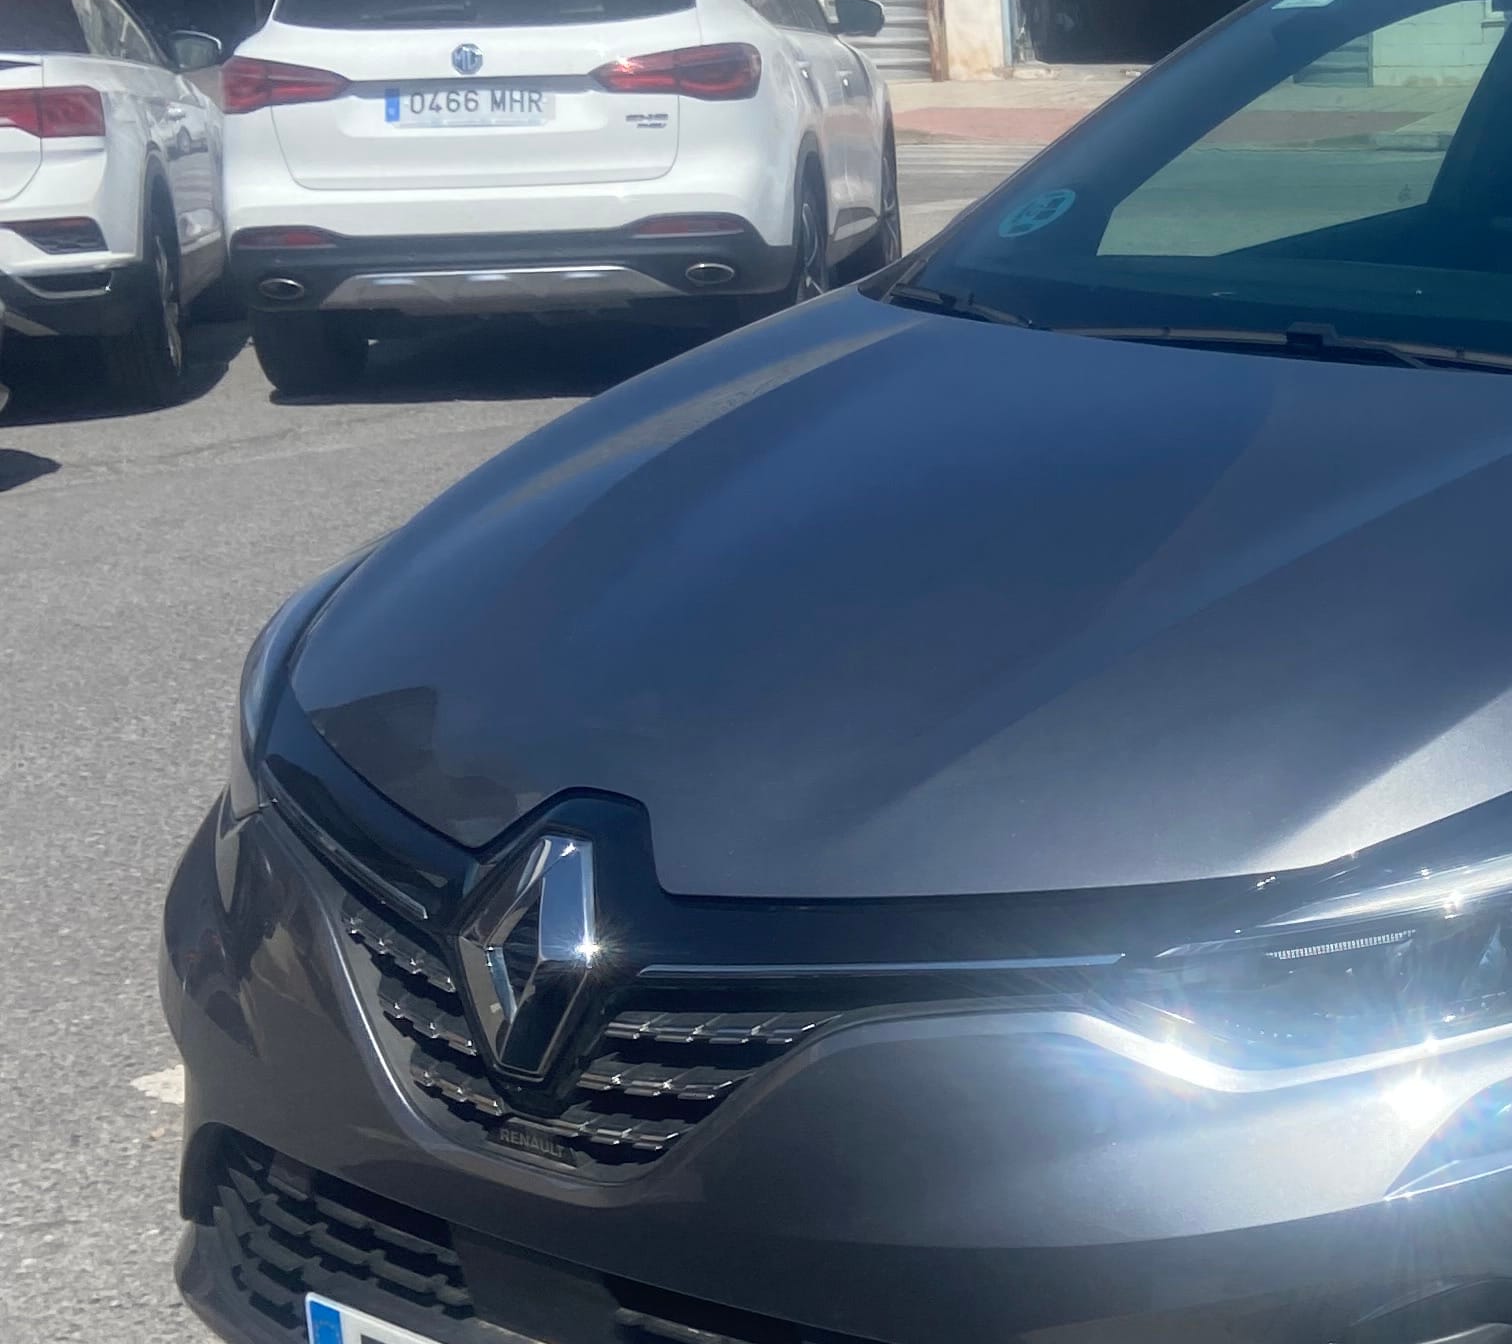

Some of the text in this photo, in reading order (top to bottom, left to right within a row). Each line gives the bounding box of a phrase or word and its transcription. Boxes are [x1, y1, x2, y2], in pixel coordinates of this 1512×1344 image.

[409, 89, 544, 115] 0466 MHR
[500, 1128, 567, 1158] RENAULT
